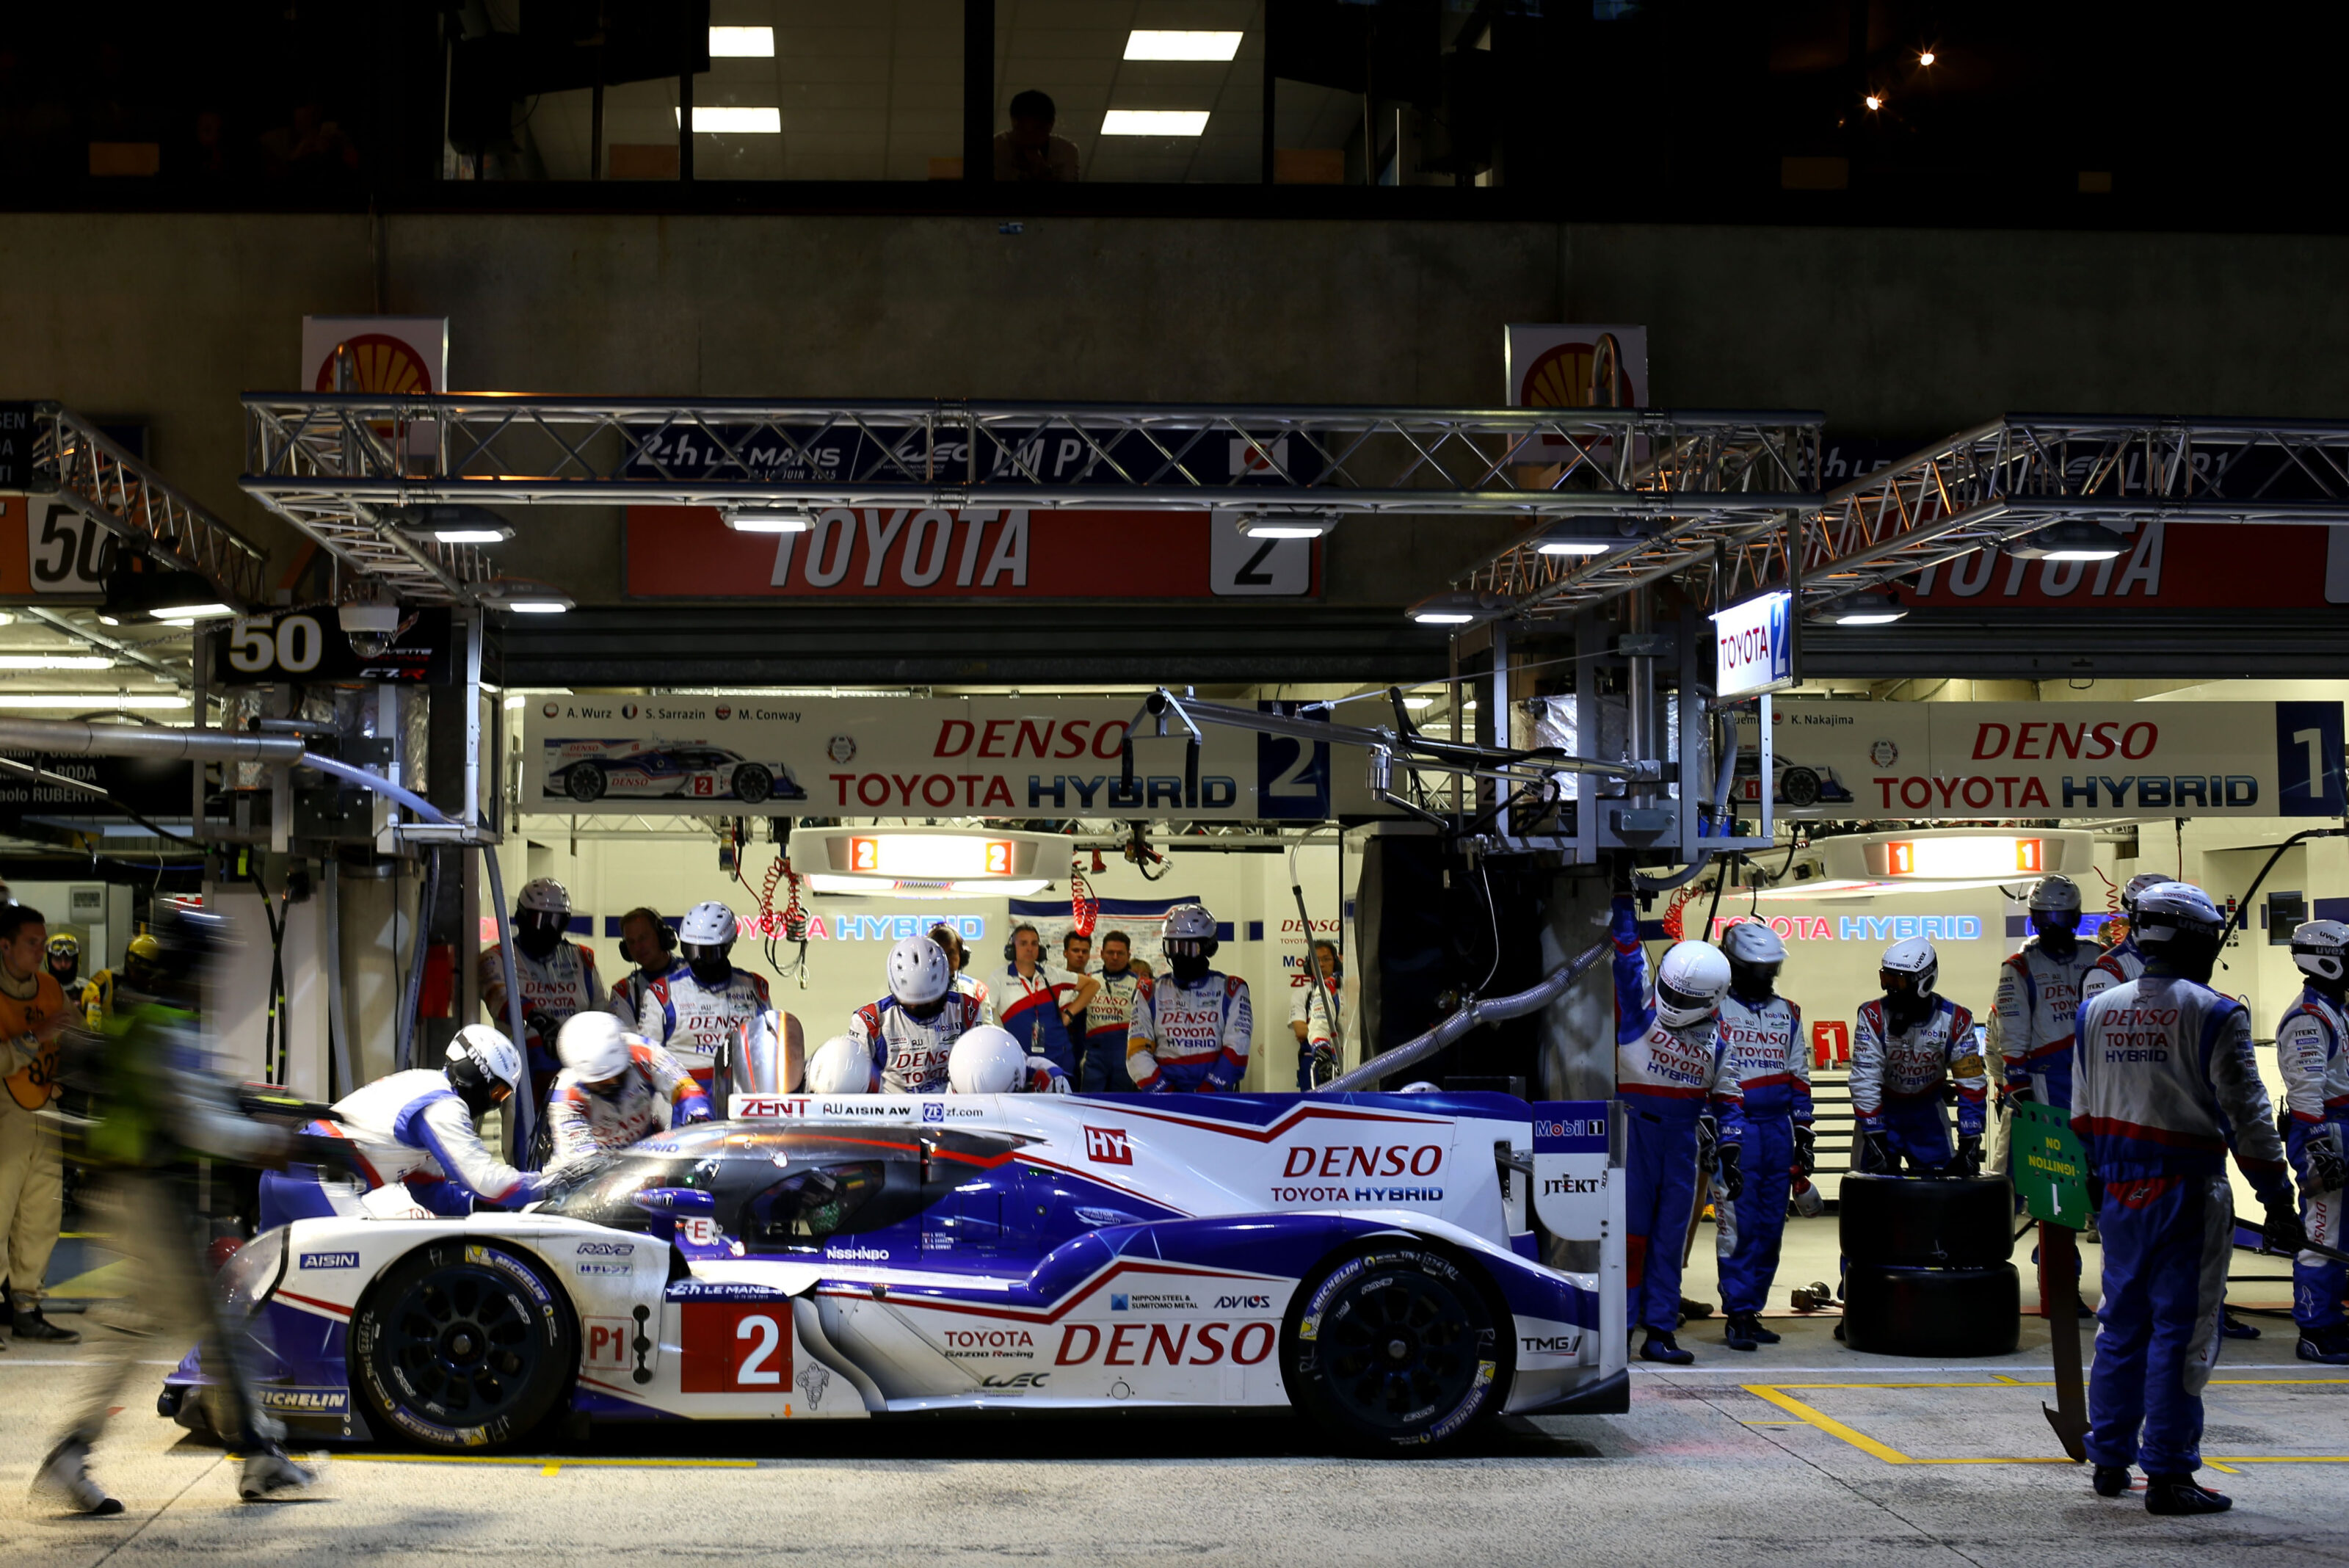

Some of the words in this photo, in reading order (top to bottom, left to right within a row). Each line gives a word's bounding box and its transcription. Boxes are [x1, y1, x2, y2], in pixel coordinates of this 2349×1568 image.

[749, 447, 841, 467] MANS
[991, 438, 1044, 477] LM
[771, 509, 1027, 587] TOYOTA
[229, 615, 322, 672] 50
[1773, 599, 1787, 675] 2
[1721, 626, 1768, 670] TOYOTA
[582, 708, 612, 719] Wurz
[658, 708, 705, 720] Sarrazin
[738, 709, 753, 721] M.
[755, 709, 802, 723] Conway
[1804, 714, 1854, 726] Nakajima
[933, 719, 1131, 759] DENSO
[1972, 721, 2158, 761] DENSO
[1267, 730, 1317, 798] 2
[2292, 727, 2324, 798] 1
[612, 777, 649, 787] DENSO
[700, 780, 708, 794] 2
[829, 774, 1016, 807] TOYOTA
[1028, 774, 1237, 808] HYBRID
[1873, 776, 2050, 808] TOYOTA
[2061, 775, 2259, 808] HYBRID
[857, 841, 875, 868] 2
[990, 842, 1006, 871] 2
[1895, 846, 1909, 872] 1
[2022, 843, 2035, 868] 1
[1840, 916, 1982, 940] HYBRID
[2319, 930, 2340, 944] uvex
[2315, 945, 2346, 956] uvex
[1913, 951, 1927, 970] uvex
[1673, 974, 1691, 988] uvex
[2045, 984, 2077, 999] DEN
[1092, 995, 1128, 1007] DENSO
[1091, 1006, 1123, 1015] TOYOTA
[1161, 1011, 1219, 1026] DENSO
[2102, 1009, 2179, 1026] DENSO
[1165, 1027, 1216, 1038] TOYOTA
[1733, 1030, 1788, 1046] DENSO
[2106, 1032, 2168, 1048] TOYOTA
[2295, 1028, 2318, 1037] JTEKT
[1166, 1039, 1216, 1048] HYBRID
[1650, 1030, 1712, 1063] DENSO
[1816, 1029, 1841, 1069] 1
[896, 1050, 950, 1069] DENS
[1651, 1048, 1704, 1077] TOYOTA
[1736, 1047, 1785, 1060] TOYOTA
[1889, 1050, 1945, 1064] DENSO
[2106, 1050, 2168, 1063] HYBRID
[466, 1046, 495, 1084] uvex
[1647, 1061, 1702, 1086] HYBRID
[1737, 1059, 1785, 1070] HYBRID
[1894, 1064, 1938, 1076] TOYOTA
[1889, 1072, 1936, 1086] HYBRID
[741, 1098, 812, 1118] ZENT
[845, 1107, 885, 1116] AISIN
[888, 1106, 912, 1116] AW
[945, 1108, 984, 1117] zf.com
[1535, 1119, 1585, 1137] Mobil
[1086, 1129, 1124, 1158] HY
[1283, 1145, 1443, 1177] DENSO
[2027, 1154, 2076, 1177] IGNITION
[1271, 1187, 1350, 1202] TOYOTA
[1354, 1186, 1444, 1202] HYBRID
[1543, 1179, 1599, 1197] JTEKT
[694, 1221, 708, 1239] E
[305, 1253, 355, 1268] AISIN
[494, 1255, 547, 1301] MICHELIN
[1312, 1260, 1360, 1310] MICHELIN
[704, 1286, 724, 1295] LE
[725, 1285, 770, 1295] MANS
[589, 1325, 624, 1362] P1
[943, 1330, 1034, 1348] TOYOTA
[1054, 1322, 1277, 1366] DENSO
[1520, 1336, 1571, 1351] TMG
[736, 1314, 780, 1385] 2
[992, 1351, 1034, 1360] Racing
[981, 1371, 1051, 1388] WEC
[1435, 1387, 1484, 1440] MICHELIN
